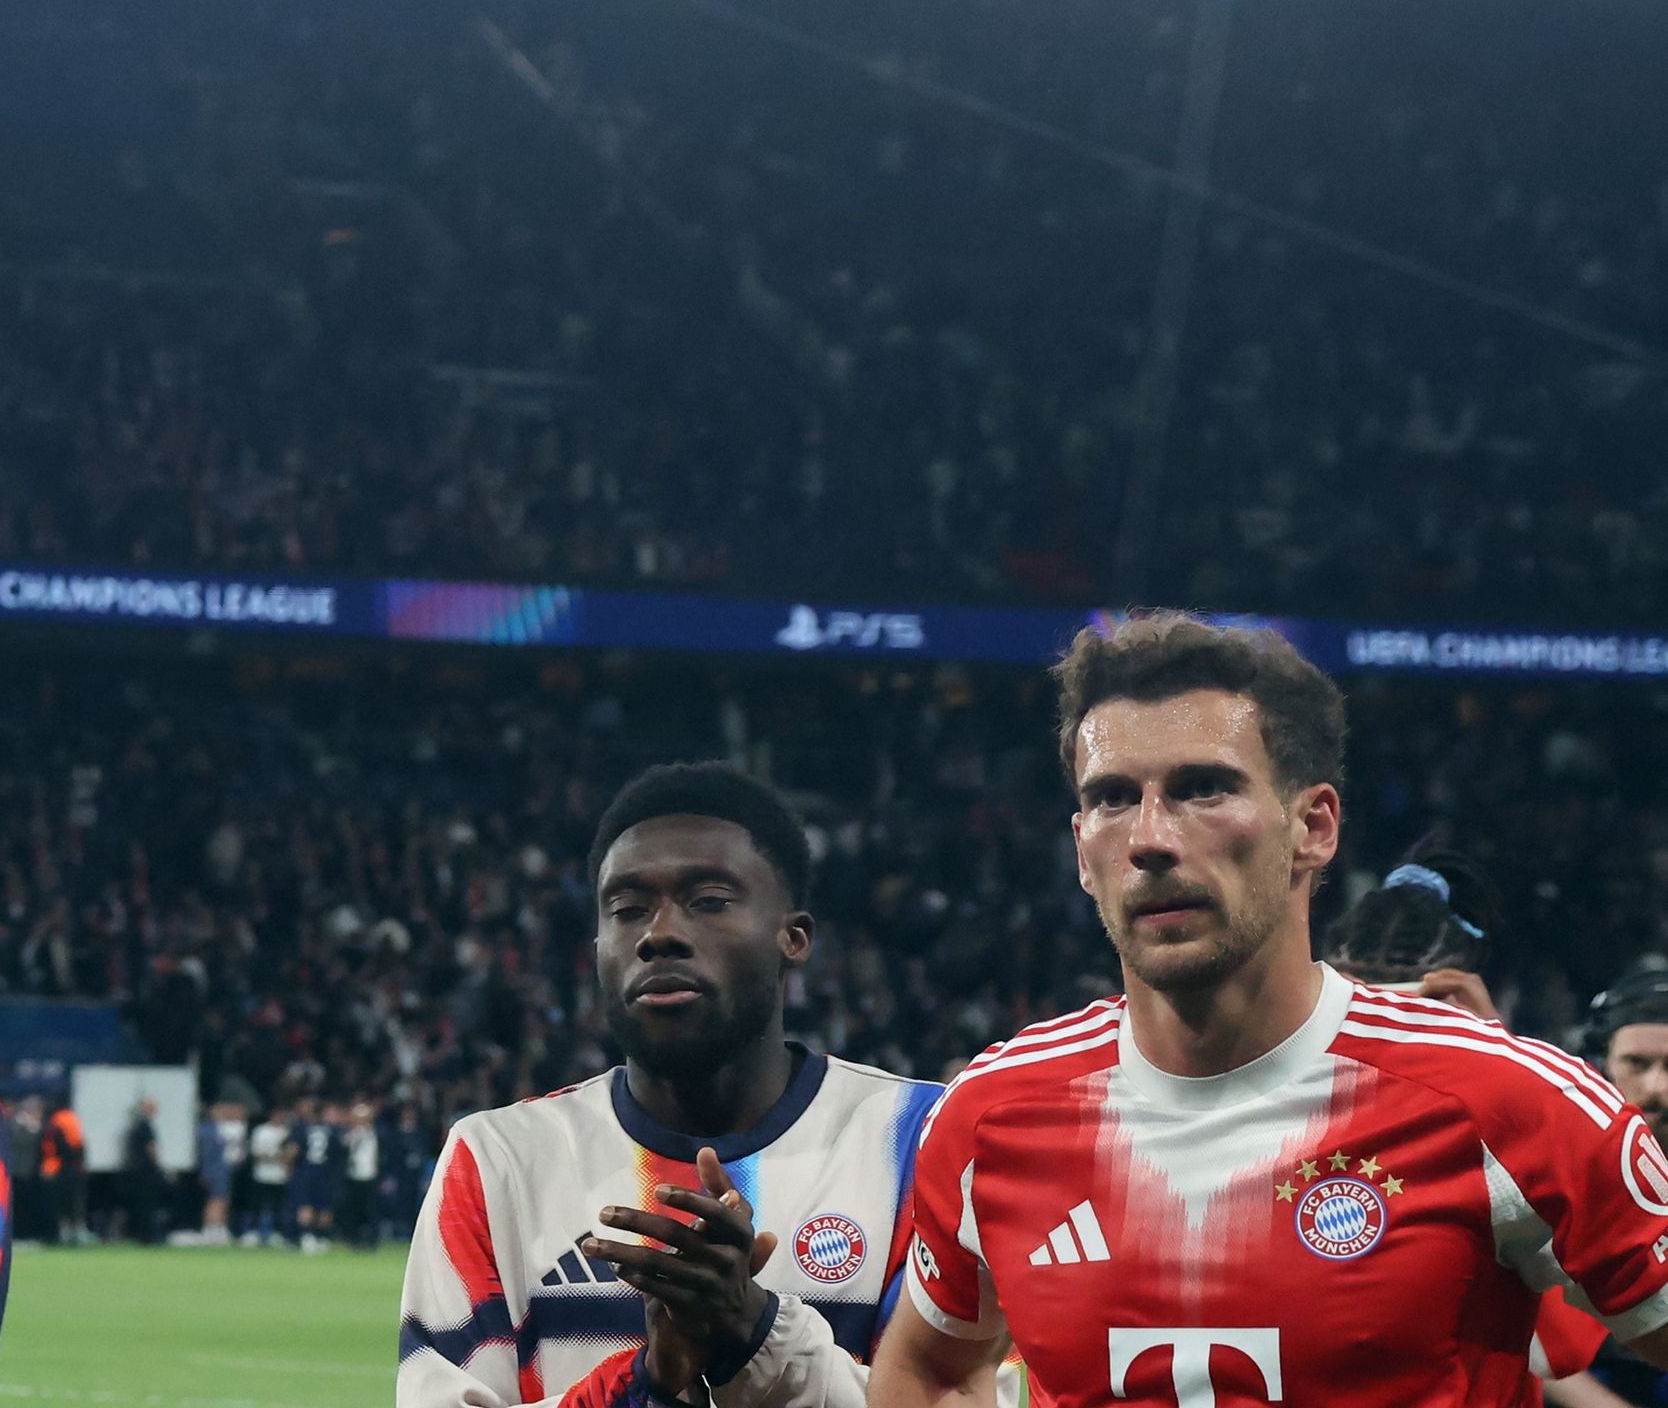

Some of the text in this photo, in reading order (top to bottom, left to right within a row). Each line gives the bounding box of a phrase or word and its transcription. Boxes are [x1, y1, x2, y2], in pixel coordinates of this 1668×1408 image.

[206, 583, 335, 625] LEAGUE
[1347, 630, 1429, 666] UEFA
[1302, 1183, 1378, 1216] FC BAYERN
[798, 1217, 861, 1244] FC BAYERN
